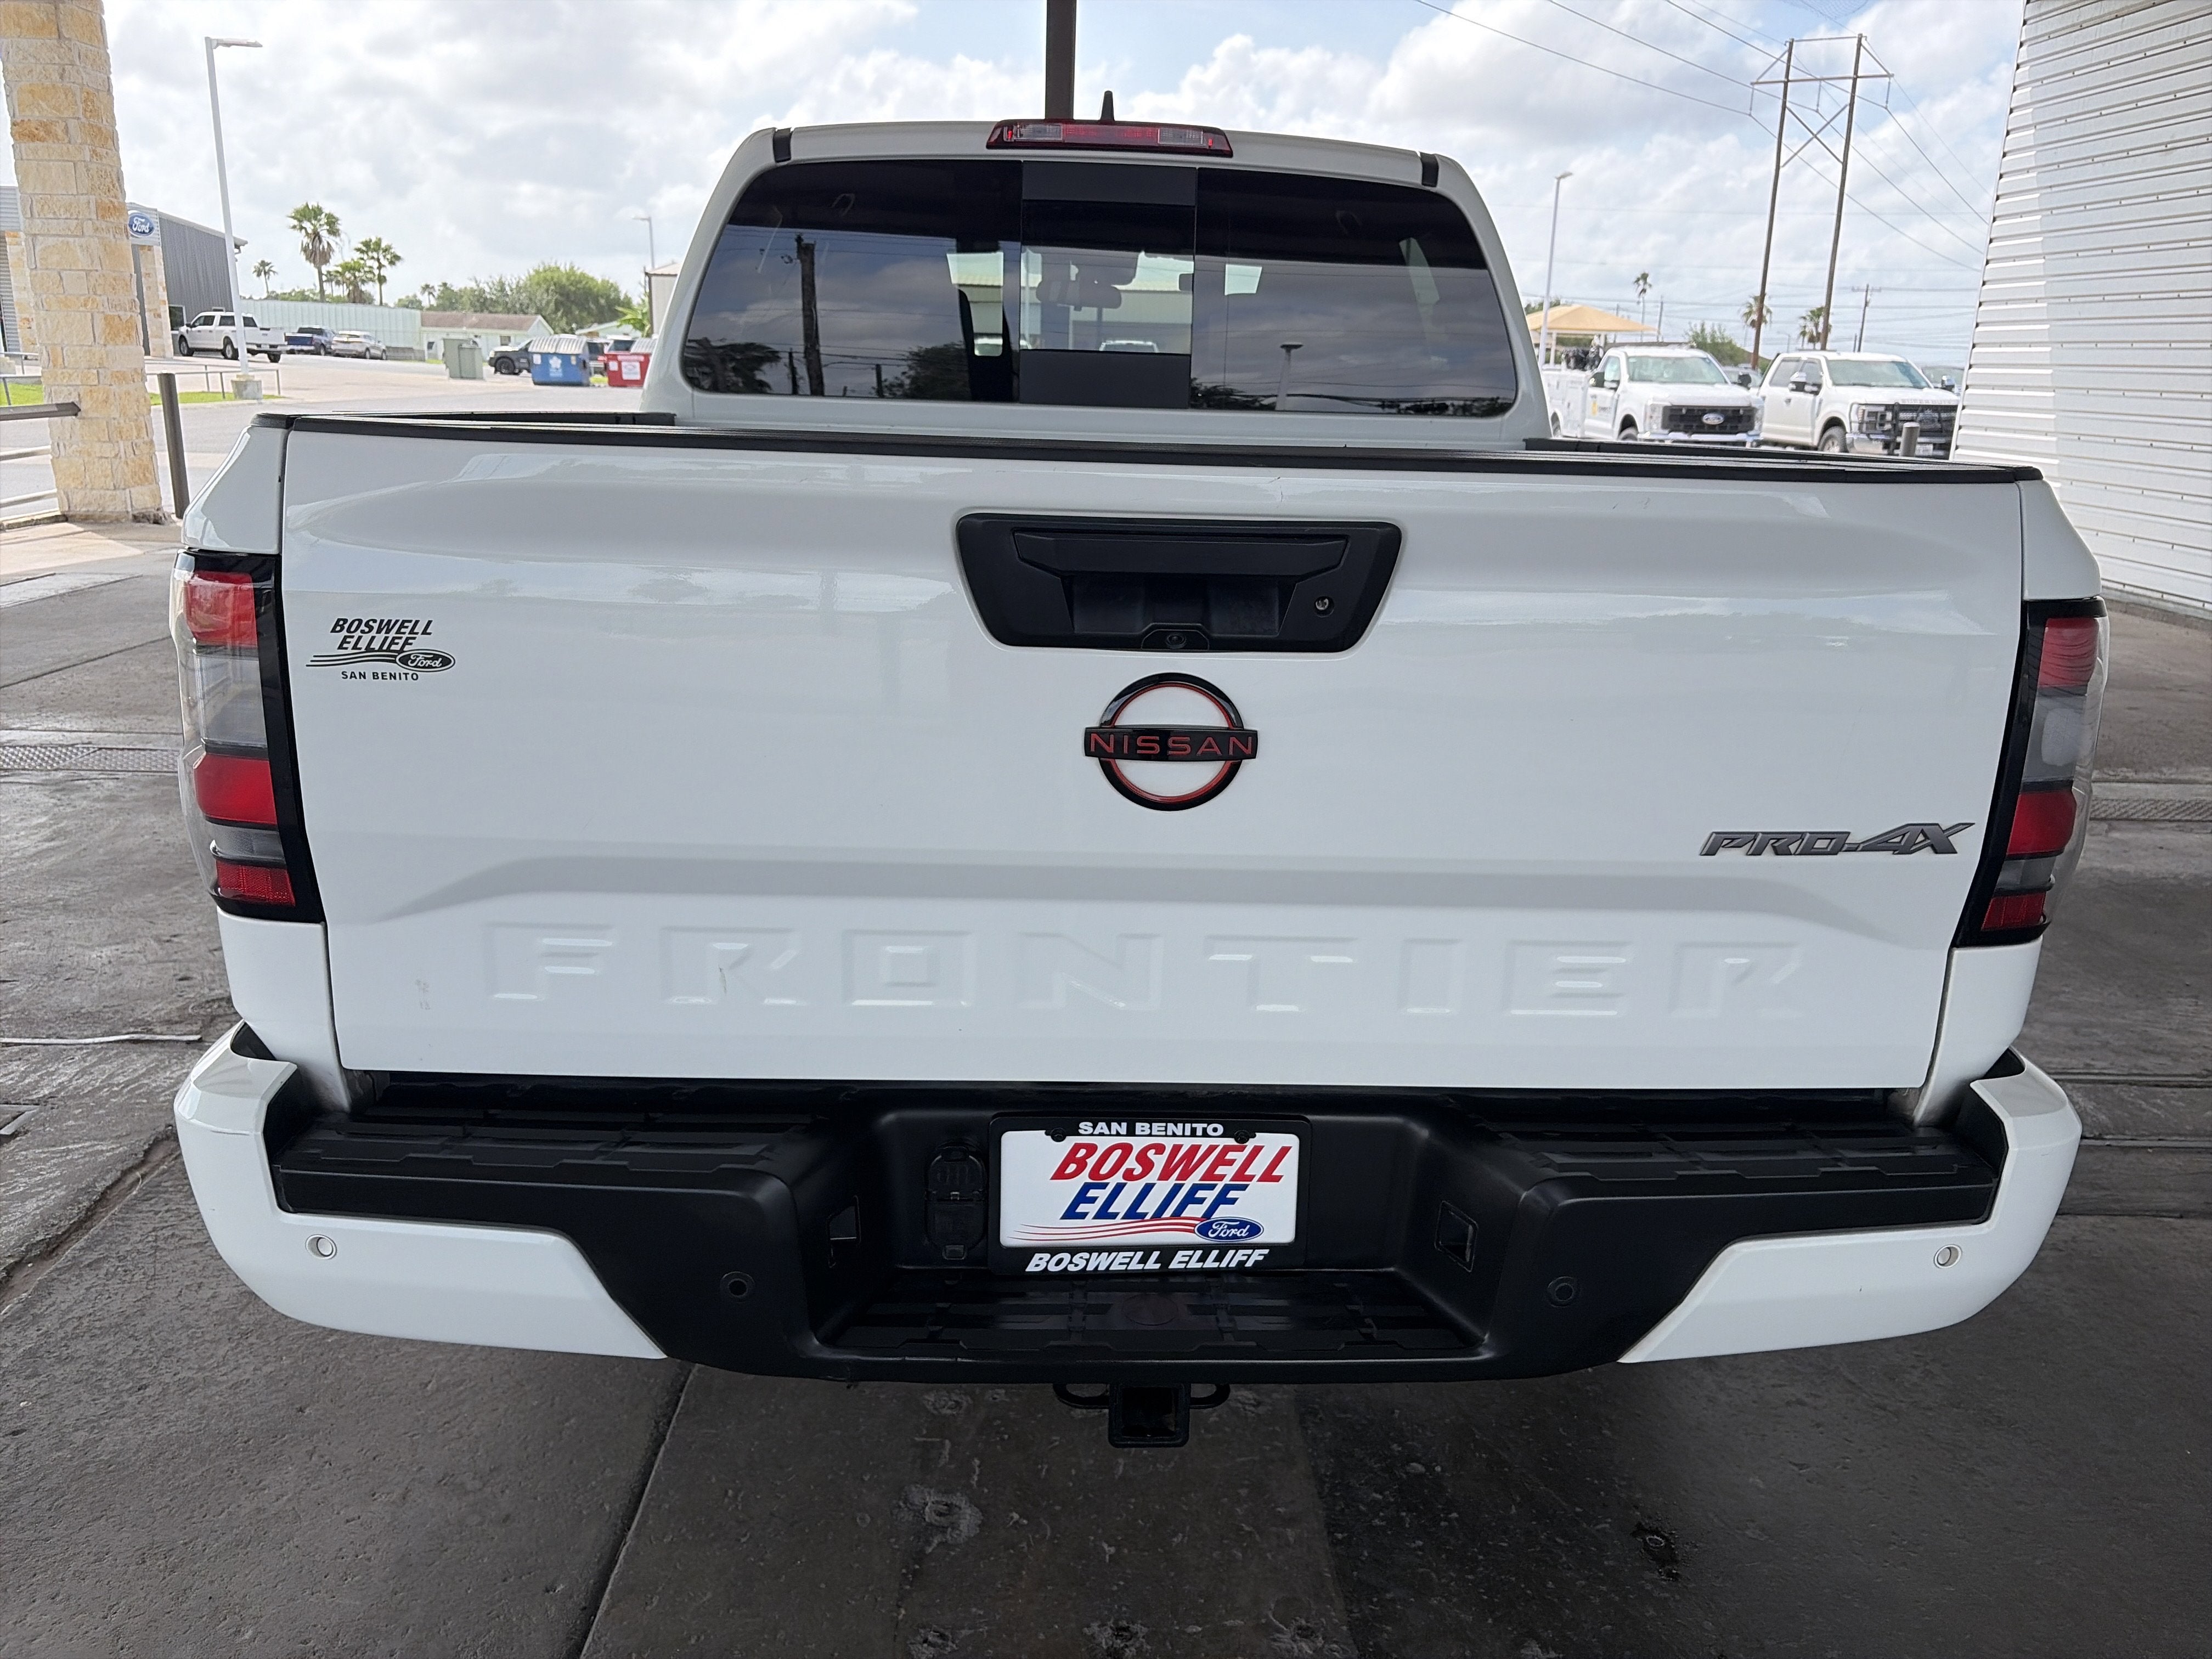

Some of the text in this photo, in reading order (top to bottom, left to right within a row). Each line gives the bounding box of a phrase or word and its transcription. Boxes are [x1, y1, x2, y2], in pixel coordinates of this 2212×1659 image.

[132, 216, 150, 233] Ford
[330, 618, 433, 636] BOSWELL
[337, 635, 417, 651] ELLIFF
[408, 653, 443, 668] Ford
[341, 671, 419, 681] SAN BENITO
[1090, 733, 1253, 757] NISSAN
[1700, 823, 1975, 856] PRO-4X
[485, 923, 1806, 1022] FRONTIER
[1078, 1122, 1224, 1137] SAN BENITO
[1050, 1142, 1293, 1183] BOSWELL
[1059, 1182, 1250, 1220] ELLIFF
[1208, 1221, 1250, 1238] Ford
[1025, 1249, 1270, 1273] BOSWELL ELLIFF
